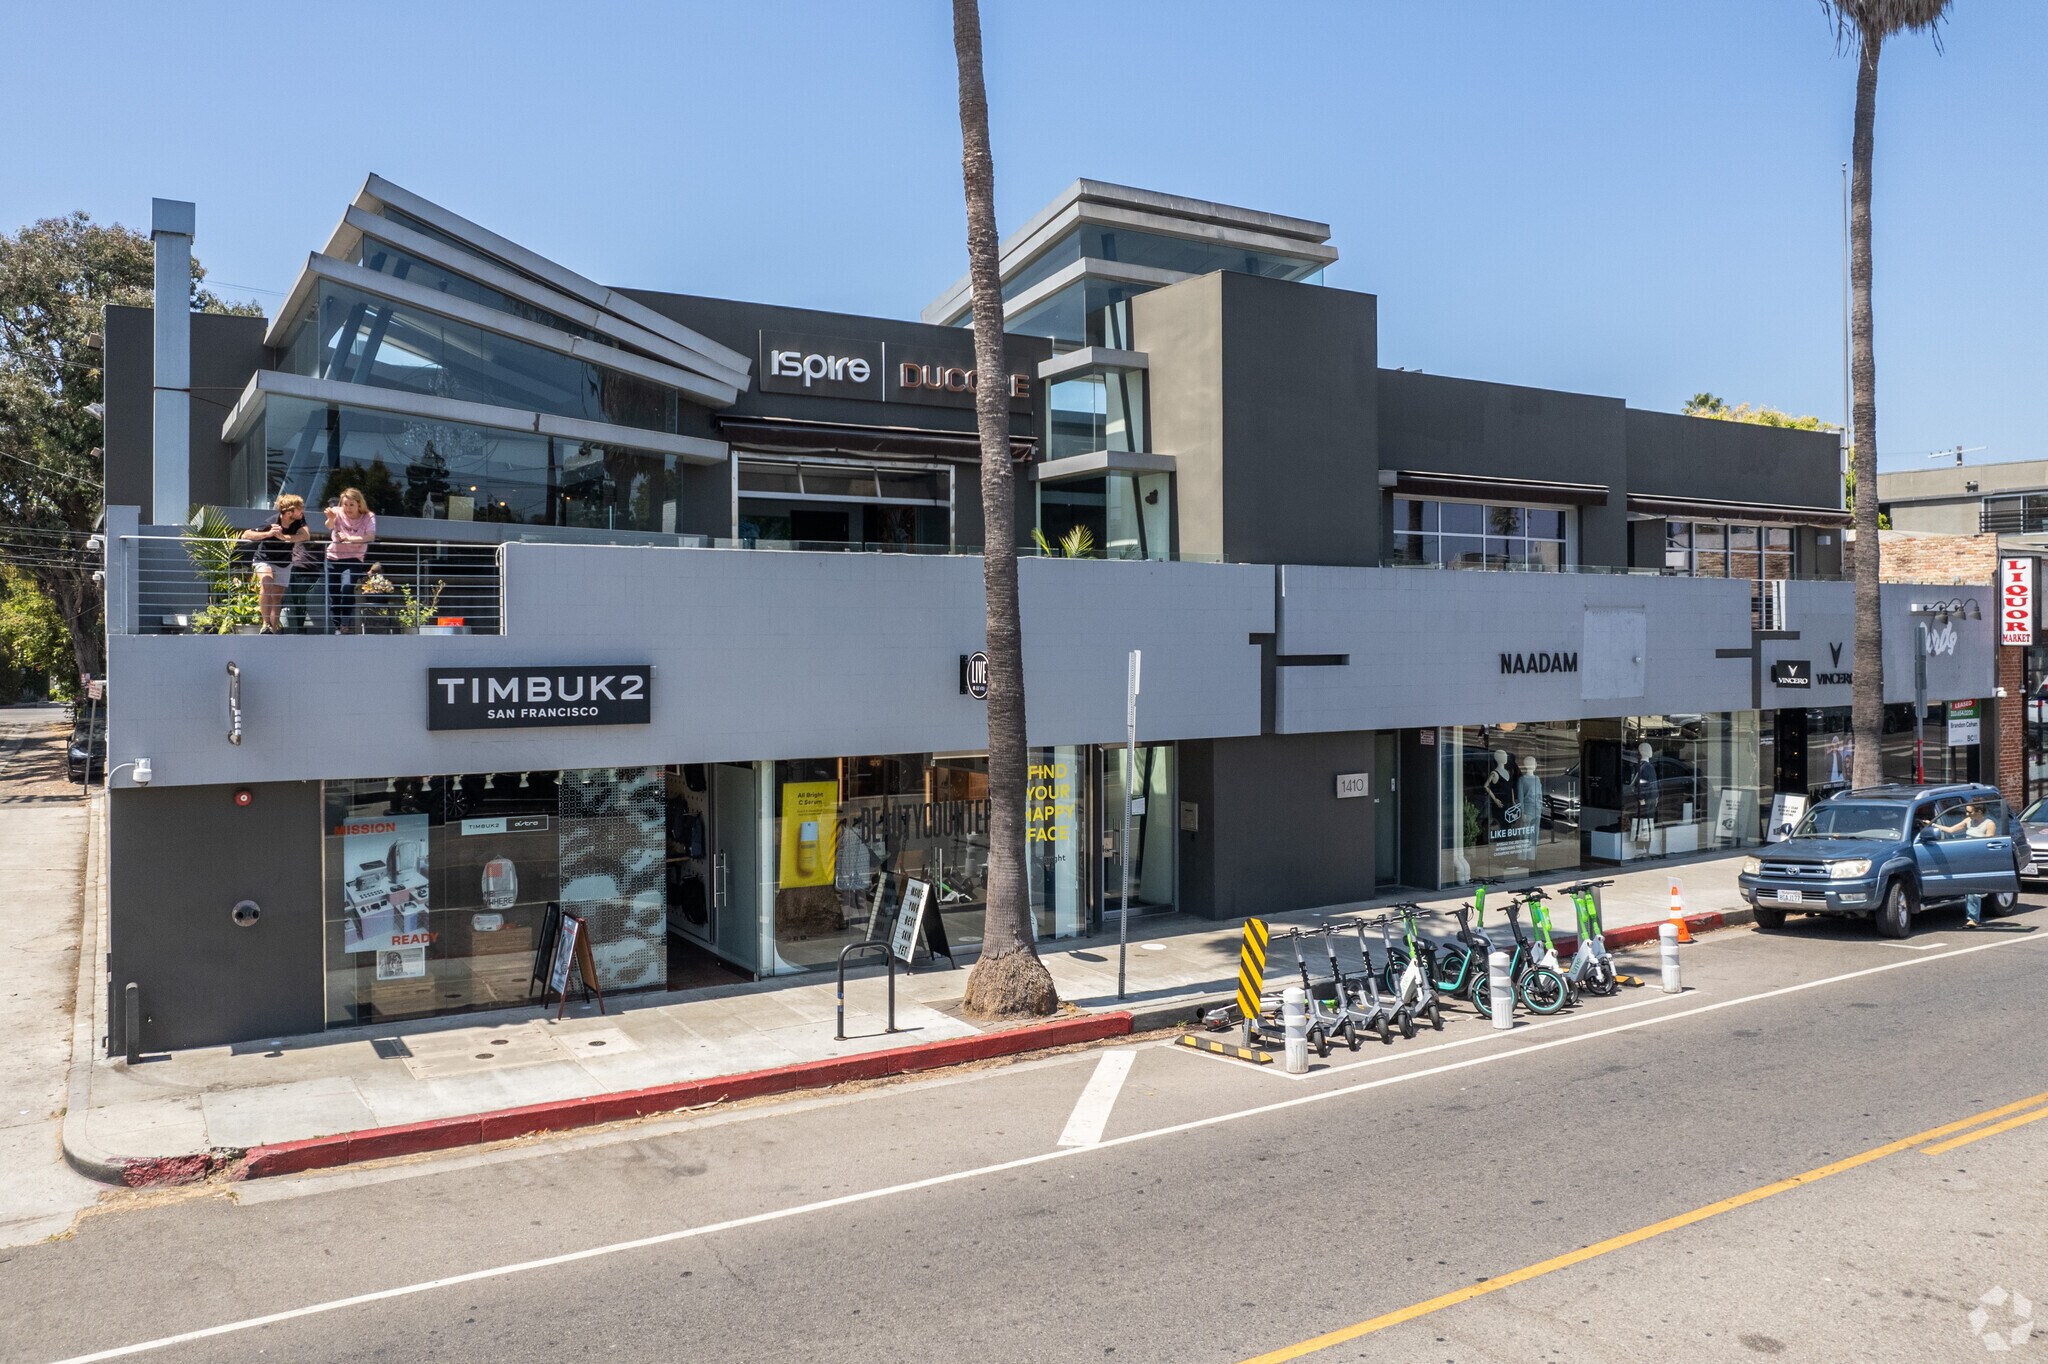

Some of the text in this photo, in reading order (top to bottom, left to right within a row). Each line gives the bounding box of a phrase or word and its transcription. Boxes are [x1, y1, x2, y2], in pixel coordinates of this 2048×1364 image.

[900, 363, 1030, 398] DUCE
[2005, 561, 2028, 632] LIQUOR
[2003, 633, 2030, 643] MARKET
[1501, 652, 1578, 674] NAADAM
[972, 661, 986, 683] LIVE
[437, 675, 644, 704] TIMBUK2
[1954, 700, 1973, 709] LEASED
[487, 707, 598, 719] SAN FRANCISCO
[1028, 764, 1067, 780] FIND
[1026, 785, 1070, 800] YOUR
[1341, 779, 1364, 792] 1410
[334, 822, 396, 836] MISSION
[1027, 825, 1069, 842] FACE
[1490, 825, 1535, 839] LIKE BUTTER
[391, 932, 439, 945] READY
